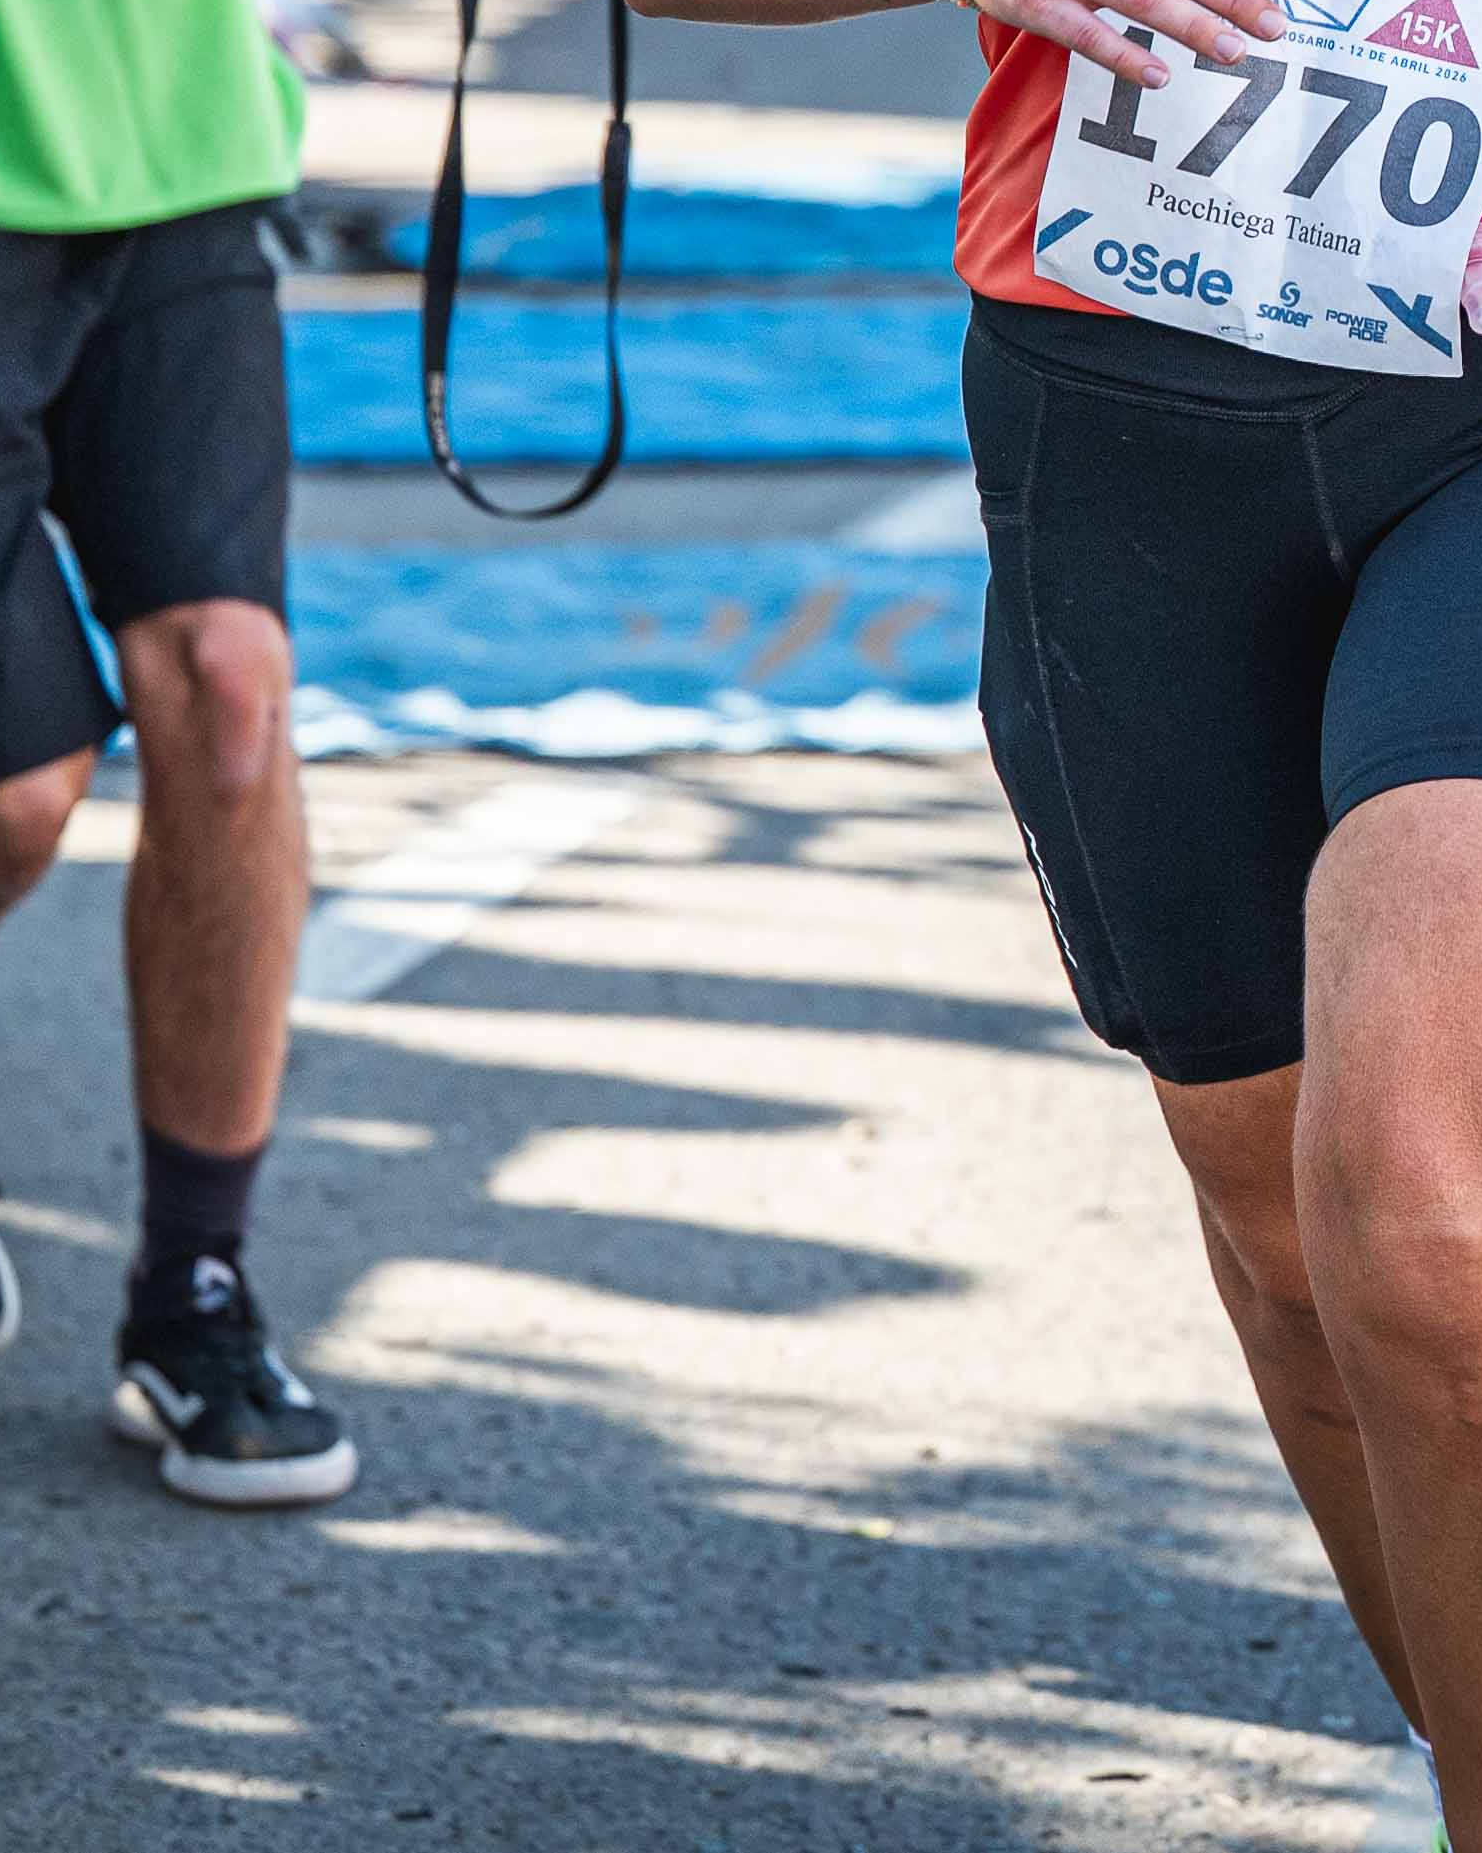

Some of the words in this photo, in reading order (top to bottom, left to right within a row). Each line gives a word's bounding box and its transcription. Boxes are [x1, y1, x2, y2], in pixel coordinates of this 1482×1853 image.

[1399, 10, 1463, 53] 15K
[1350, 44, 1364, 57] 12
[1369, 50, 1386, 63] DE
[1390, 55, 1429, 75] ABRIL
[1435, 66, 1468, 83] 2026
[1078, 23, 1482, 228] 1770
[1146, 182, 1275, 238] Pacchiega
[1284, 214, 1362, 256] Tatiana
[1093, 239, 1233, 306] osde
[1325, 309, 1388, 332] POWER
